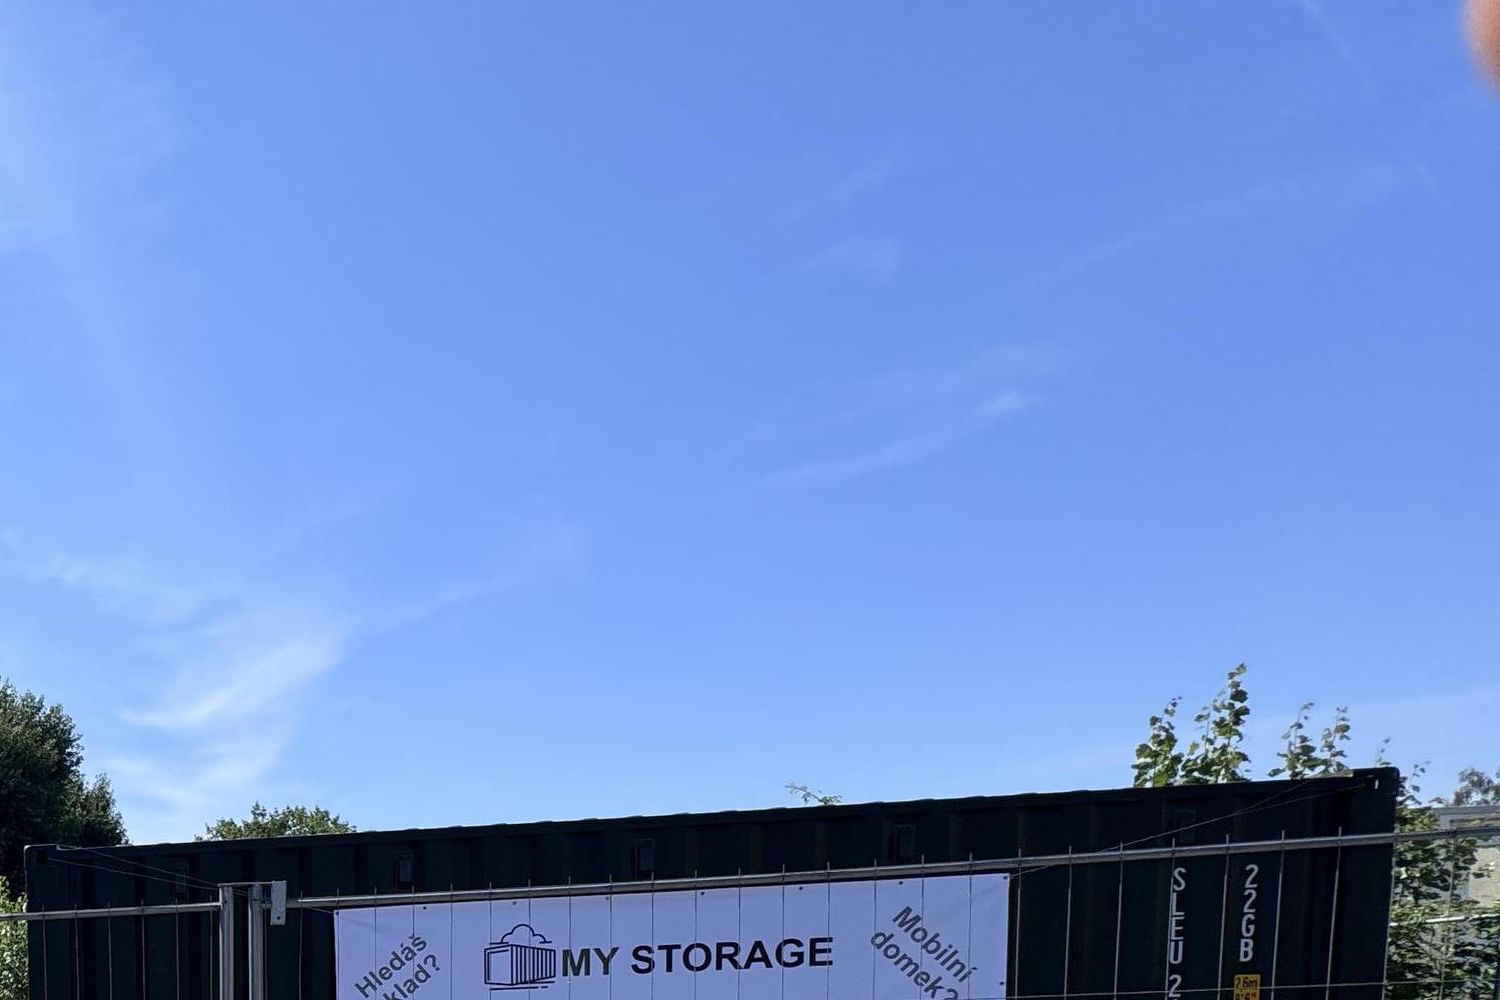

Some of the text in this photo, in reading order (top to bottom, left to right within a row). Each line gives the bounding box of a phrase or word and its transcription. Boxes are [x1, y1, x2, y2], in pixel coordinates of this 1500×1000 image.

[892, 906, 978, 983] Mobilní
[1169, 867, 1187, 964] SLEU
[1239, 864, 1259, 962] 22GB
[354, 933, 427, 1000] Hledáš
[562, 937, 834, 977] MY STORAGE
